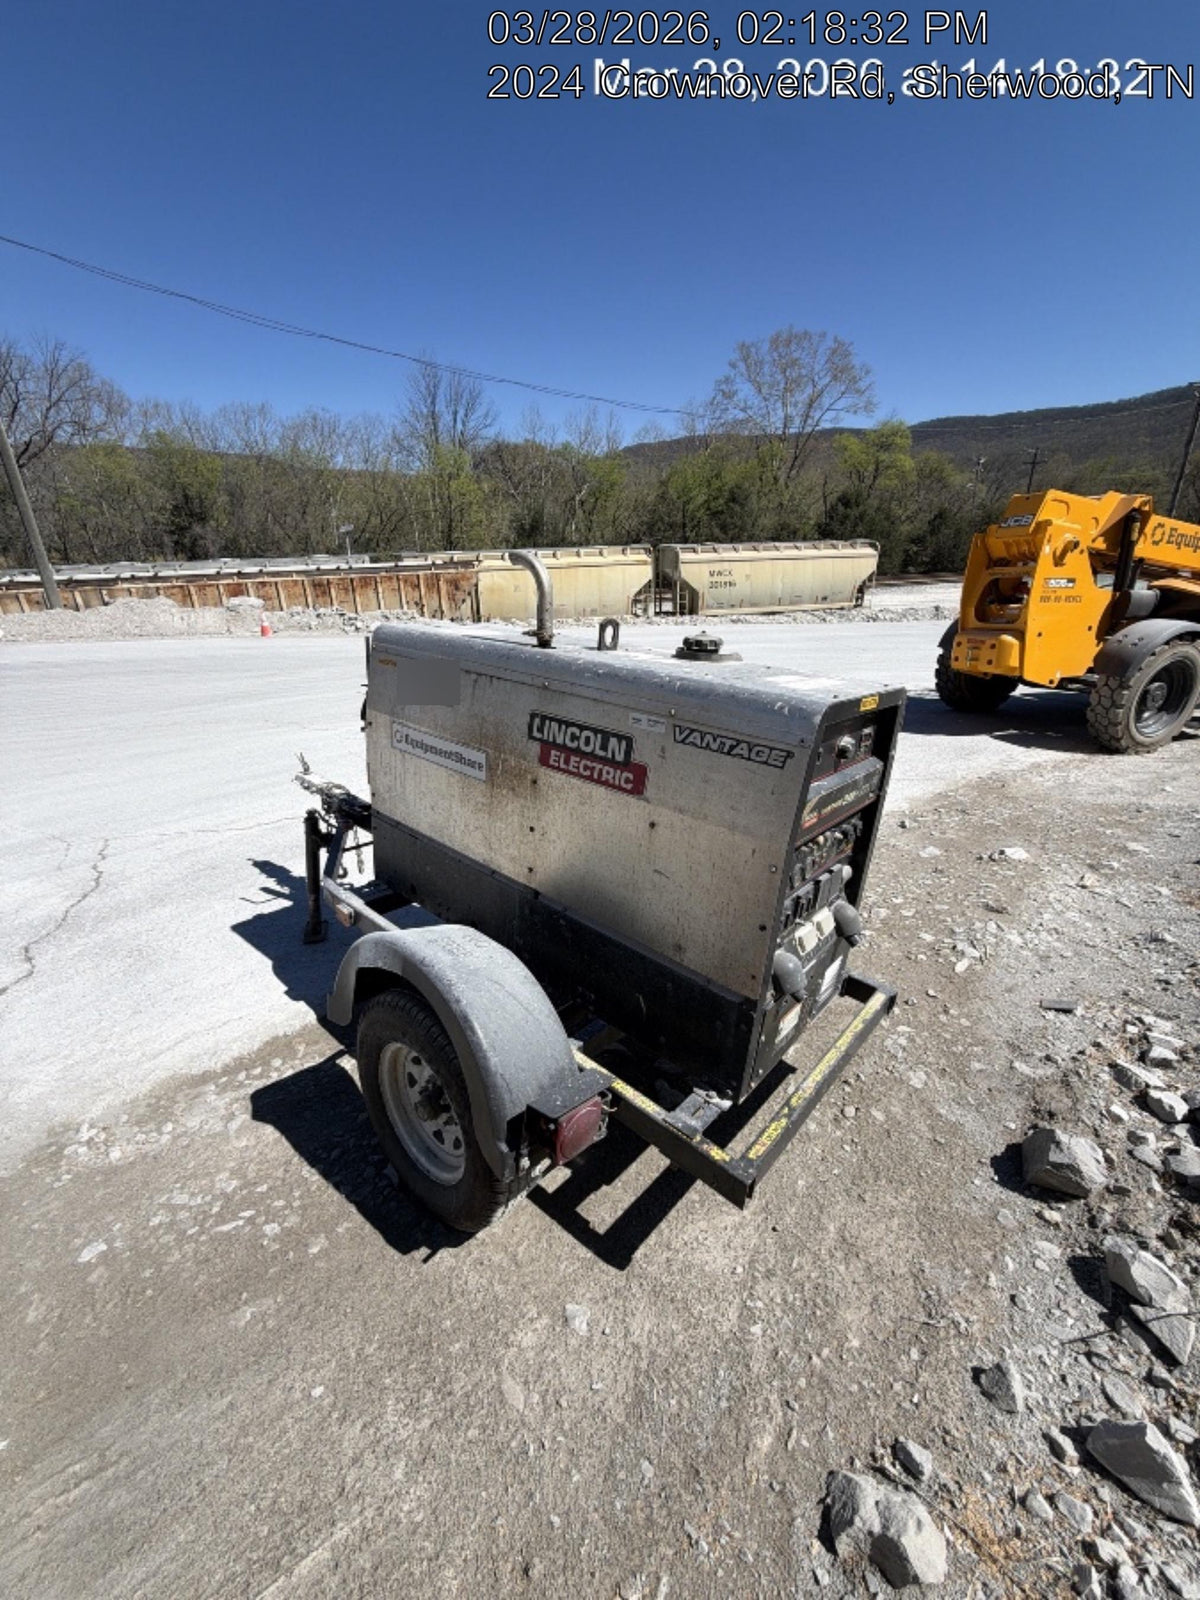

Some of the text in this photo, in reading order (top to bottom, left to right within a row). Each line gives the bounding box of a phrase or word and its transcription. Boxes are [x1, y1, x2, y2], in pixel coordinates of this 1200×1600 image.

[405, 733, 484, 772] EquipmentShare
[532, 713, 626, 762] LINCOLN
[673, 724, 789, 769] VANTAGE
[550, 750, 634, 790] ELECTRIC
